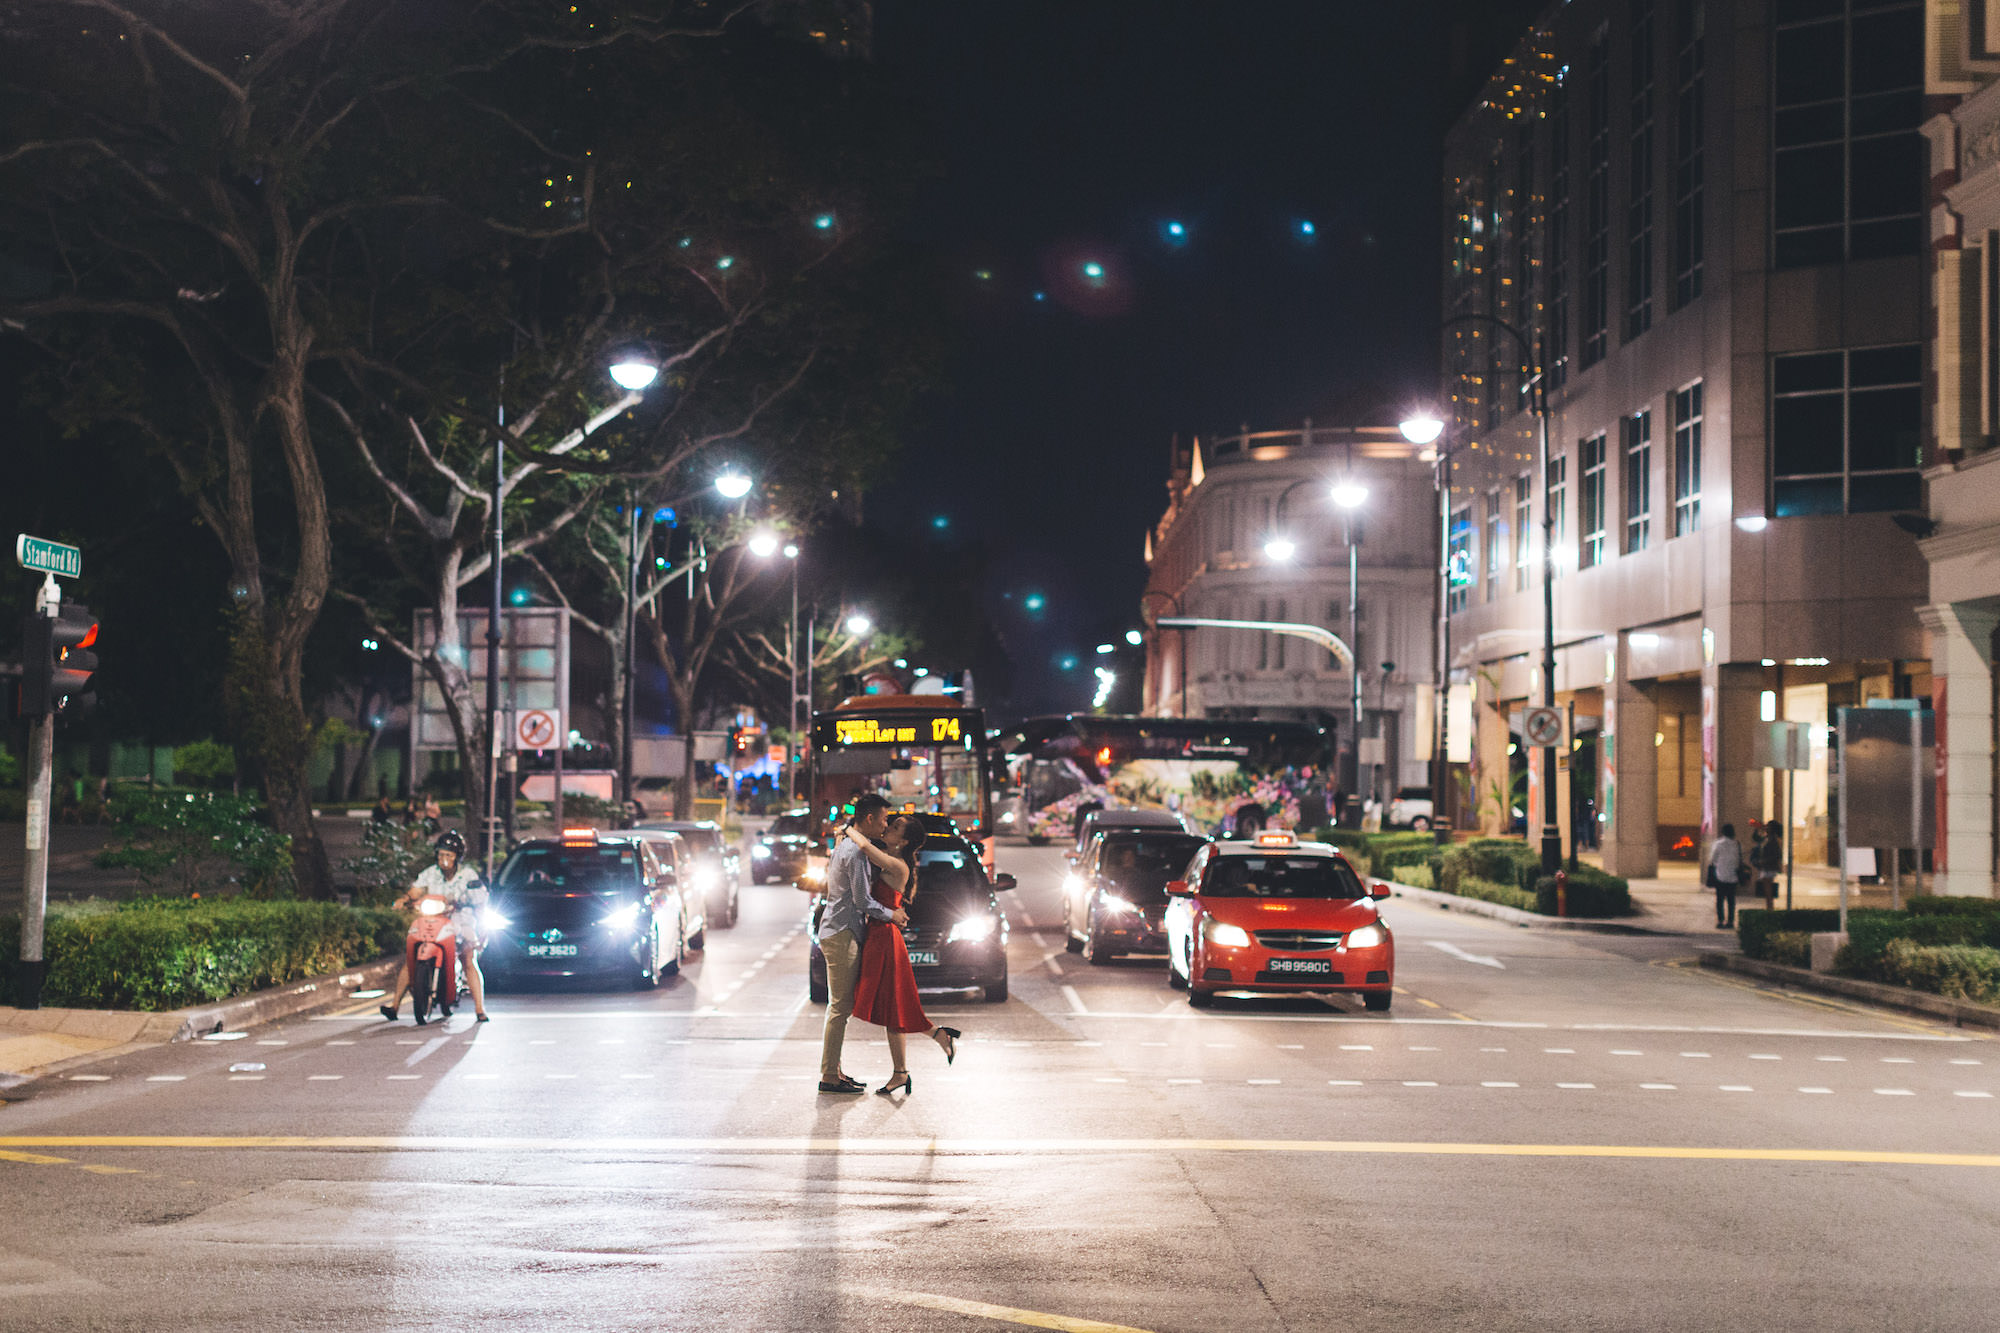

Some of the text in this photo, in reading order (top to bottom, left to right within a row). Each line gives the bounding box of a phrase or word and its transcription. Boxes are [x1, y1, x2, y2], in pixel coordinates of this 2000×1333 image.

[26, 540, 77, 573] Stamford Rd
[875, 728, 896, 742] LAY
[897, 728, 916, 741] INT
[931, 718, 961, 741] 174
